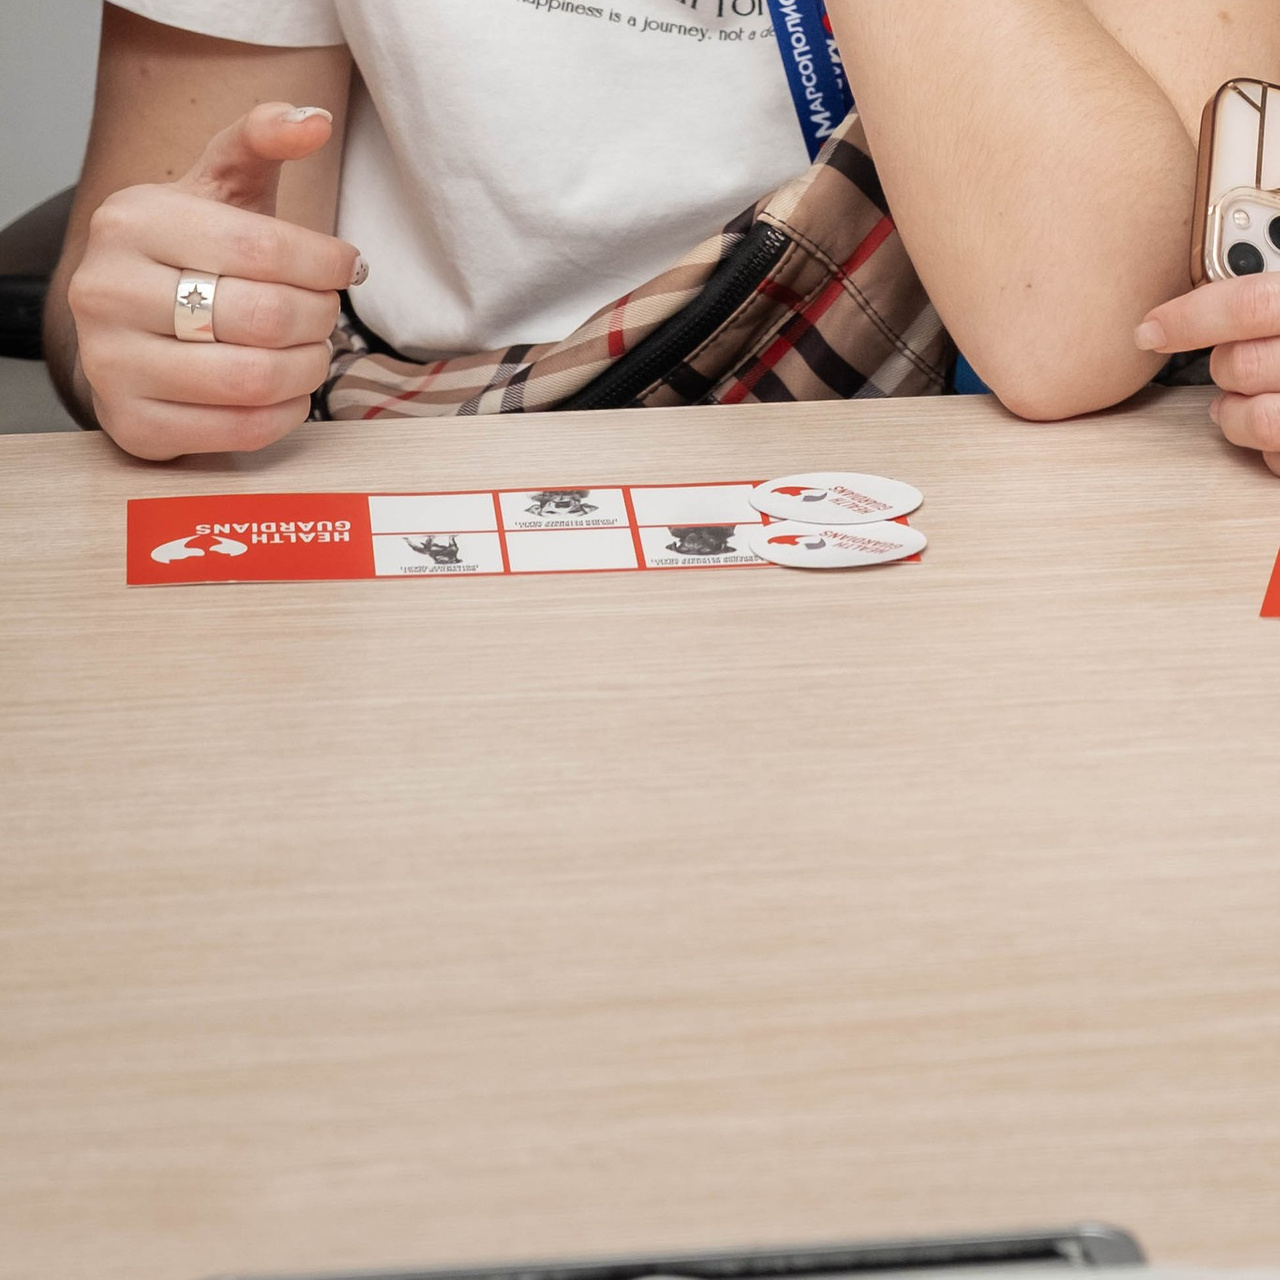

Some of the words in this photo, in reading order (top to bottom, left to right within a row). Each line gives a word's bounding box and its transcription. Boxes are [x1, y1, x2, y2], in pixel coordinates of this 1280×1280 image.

[608, 7, 623, 25] is
[627, 14, 637, 28] a
[718, 28, 744, 42] not
[195, 520, 351, 535] GUARDIANS
[252, 532, 350, 545] HEALTH
